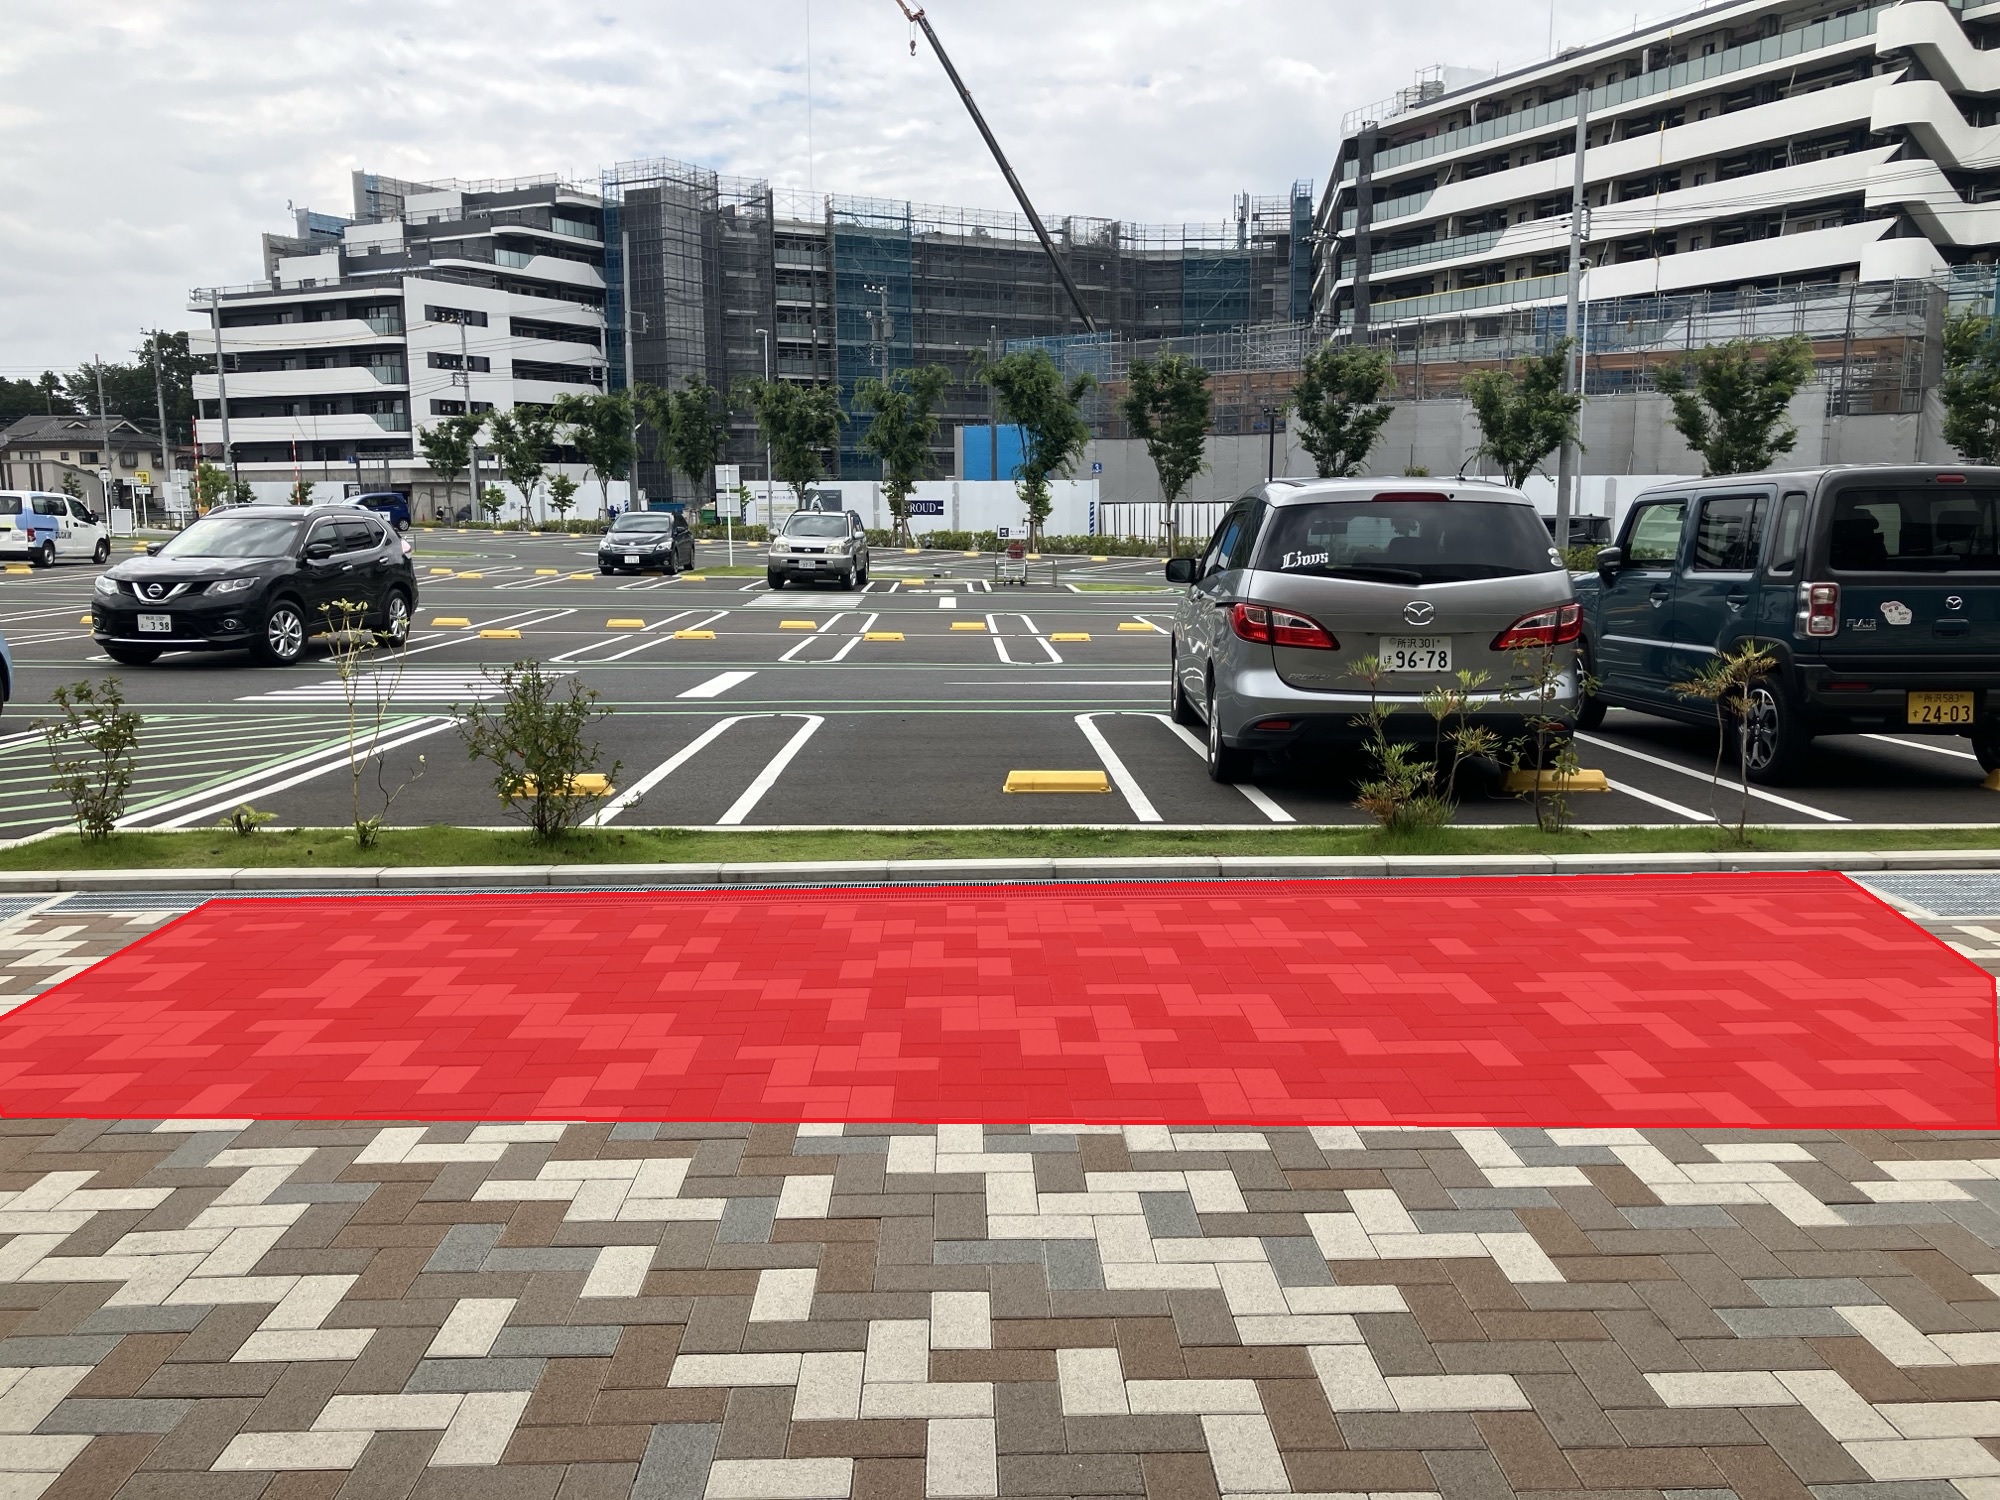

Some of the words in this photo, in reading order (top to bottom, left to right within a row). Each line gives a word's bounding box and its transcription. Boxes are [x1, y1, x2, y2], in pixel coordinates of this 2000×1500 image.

[905, 503, 936, 513] ROUD
[1280, 551, 1329, 570] Lions
[1395, 650, 1447, 669] 96-78
[1922, 705, 1970, 722] 24-03
